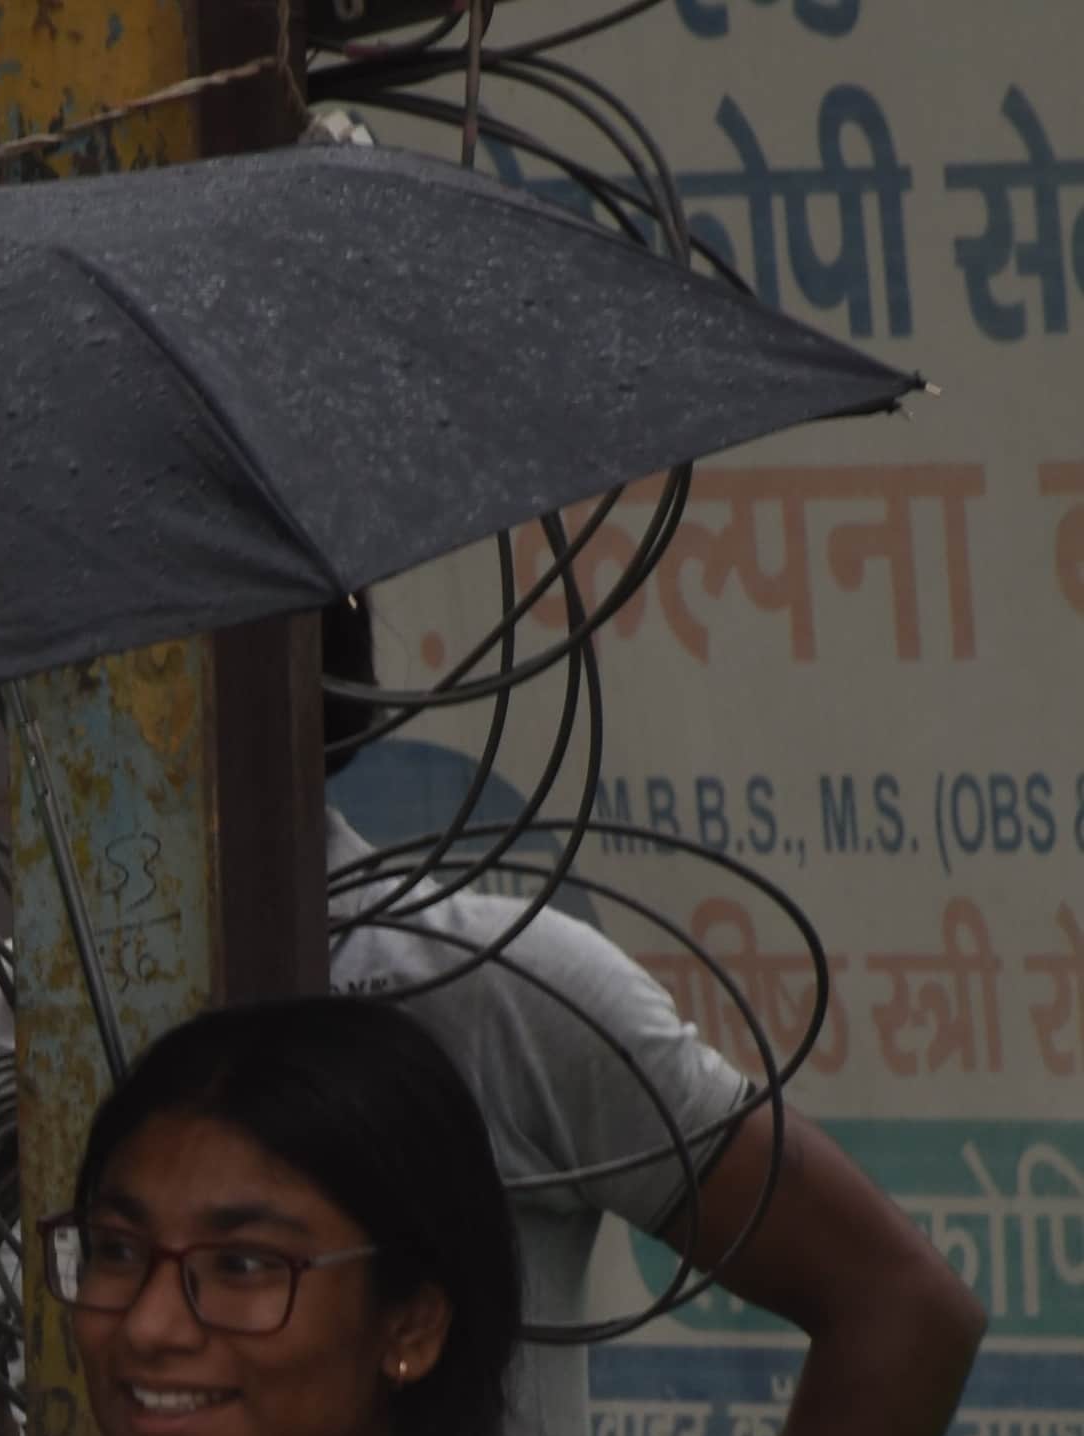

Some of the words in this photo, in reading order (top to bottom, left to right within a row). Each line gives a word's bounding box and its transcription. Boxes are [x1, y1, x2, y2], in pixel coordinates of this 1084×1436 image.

[944, 82, 1084, 342] से
[820, 774, 919, 855] M.S.
[936, 772, 1056, 873] (OBS
